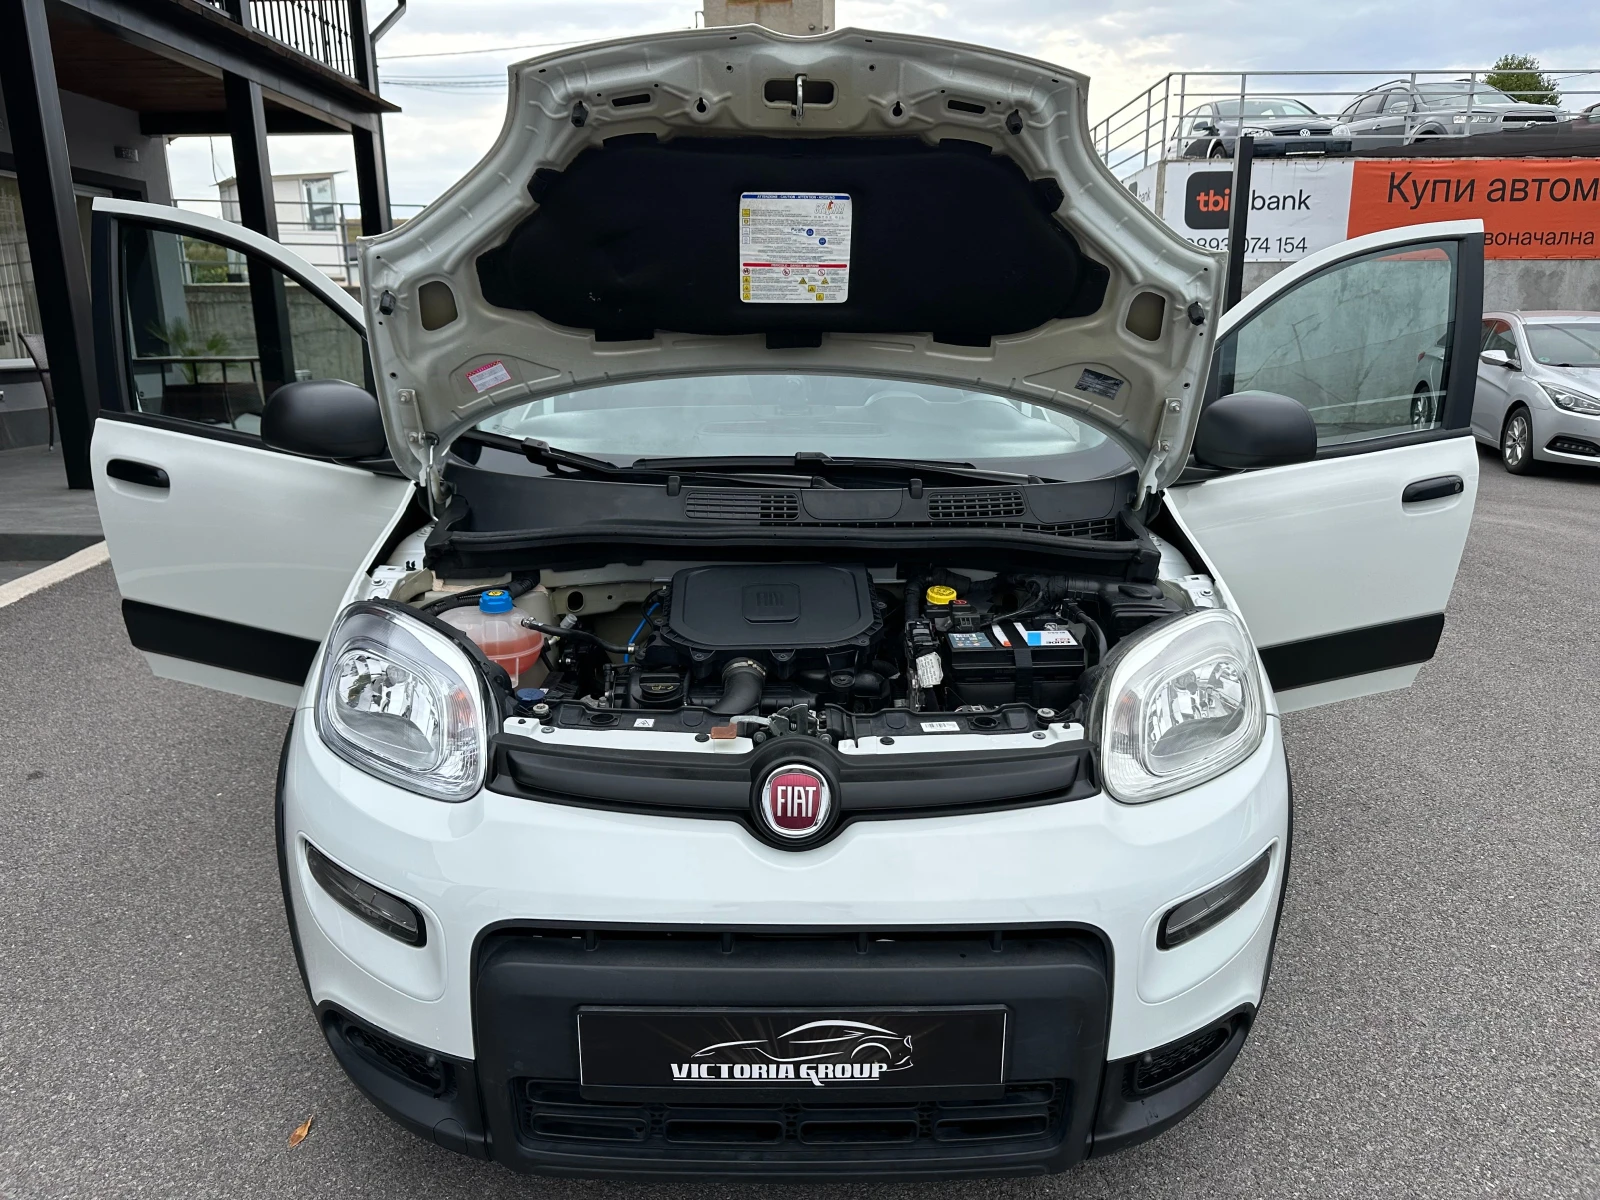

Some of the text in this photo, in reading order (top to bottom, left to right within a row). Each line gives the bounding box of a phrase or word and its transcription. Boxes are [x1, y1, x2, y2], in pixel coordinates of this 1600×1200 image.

[1196, 188, 1311, 211] tbi bank
[1387, 171, 1600, 209] Купи автом
[1275, 237, 1308, 253] 154
[777, 785, 816, 817] FIAT
[671, 1062, 888, 1086] VICTORIA GROUP
